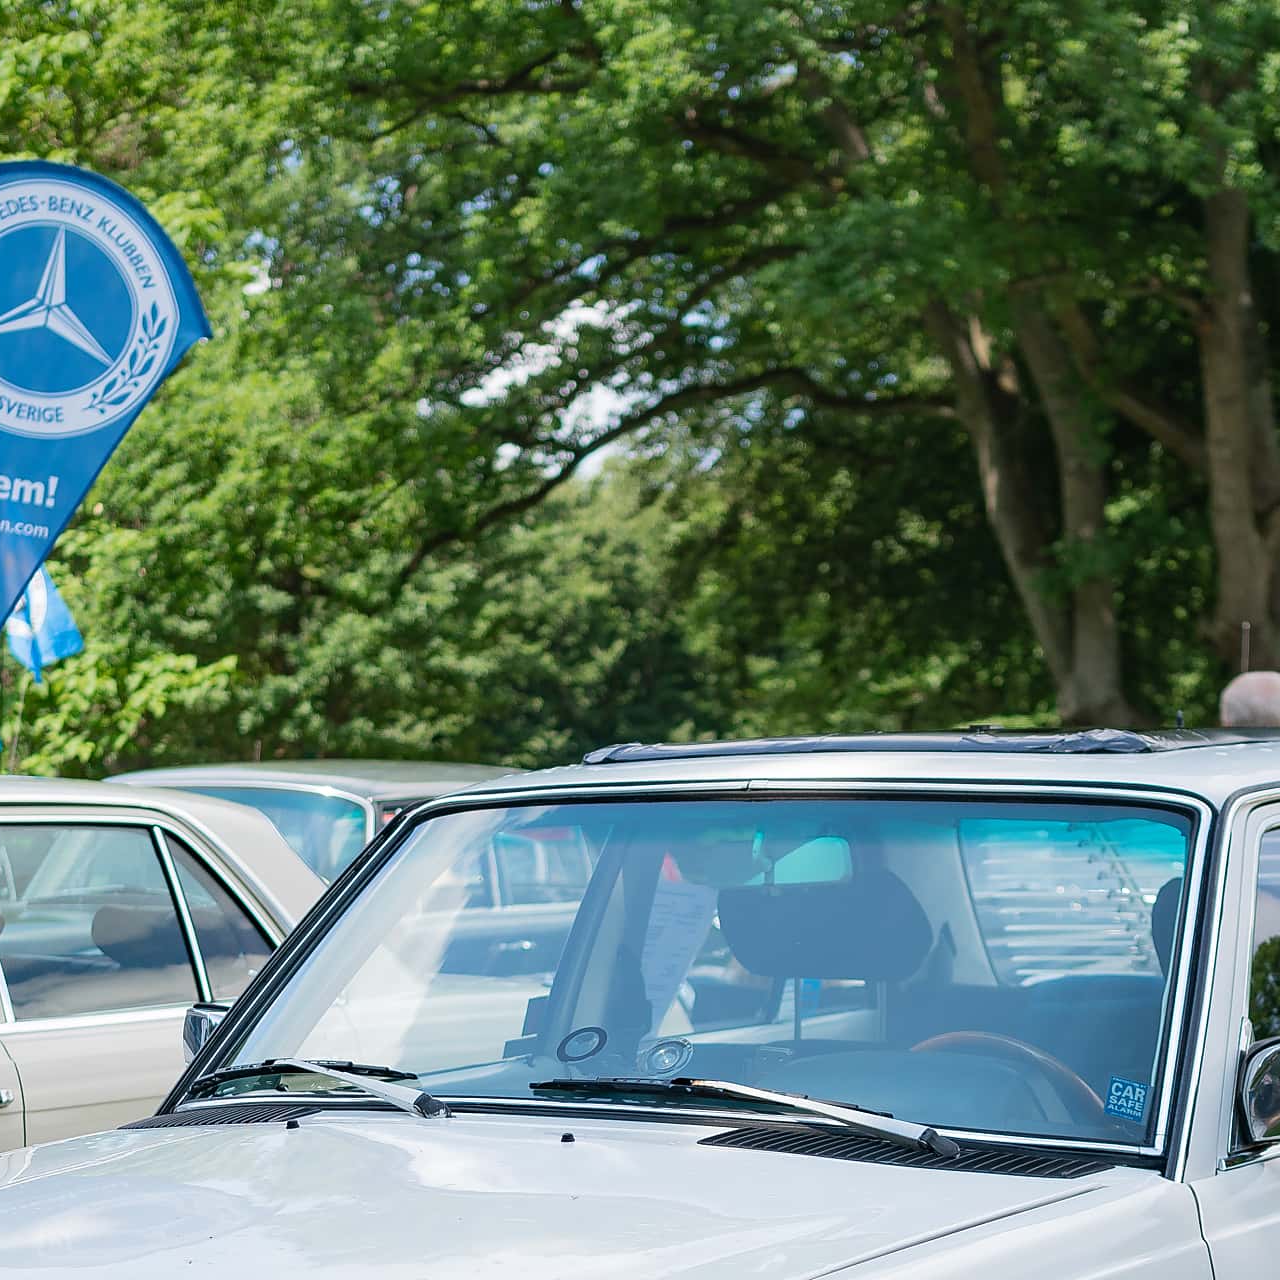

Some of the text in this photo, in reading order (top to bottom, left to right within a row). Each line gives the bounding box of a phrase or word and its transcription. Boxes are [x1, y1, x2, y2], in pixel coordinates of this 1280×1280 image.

[98, 216, 156, 289] KLUBBEN
[1111, 1082, 1146, 1103] CAR
[1109, 1095, 1144, 1112] SAFE
